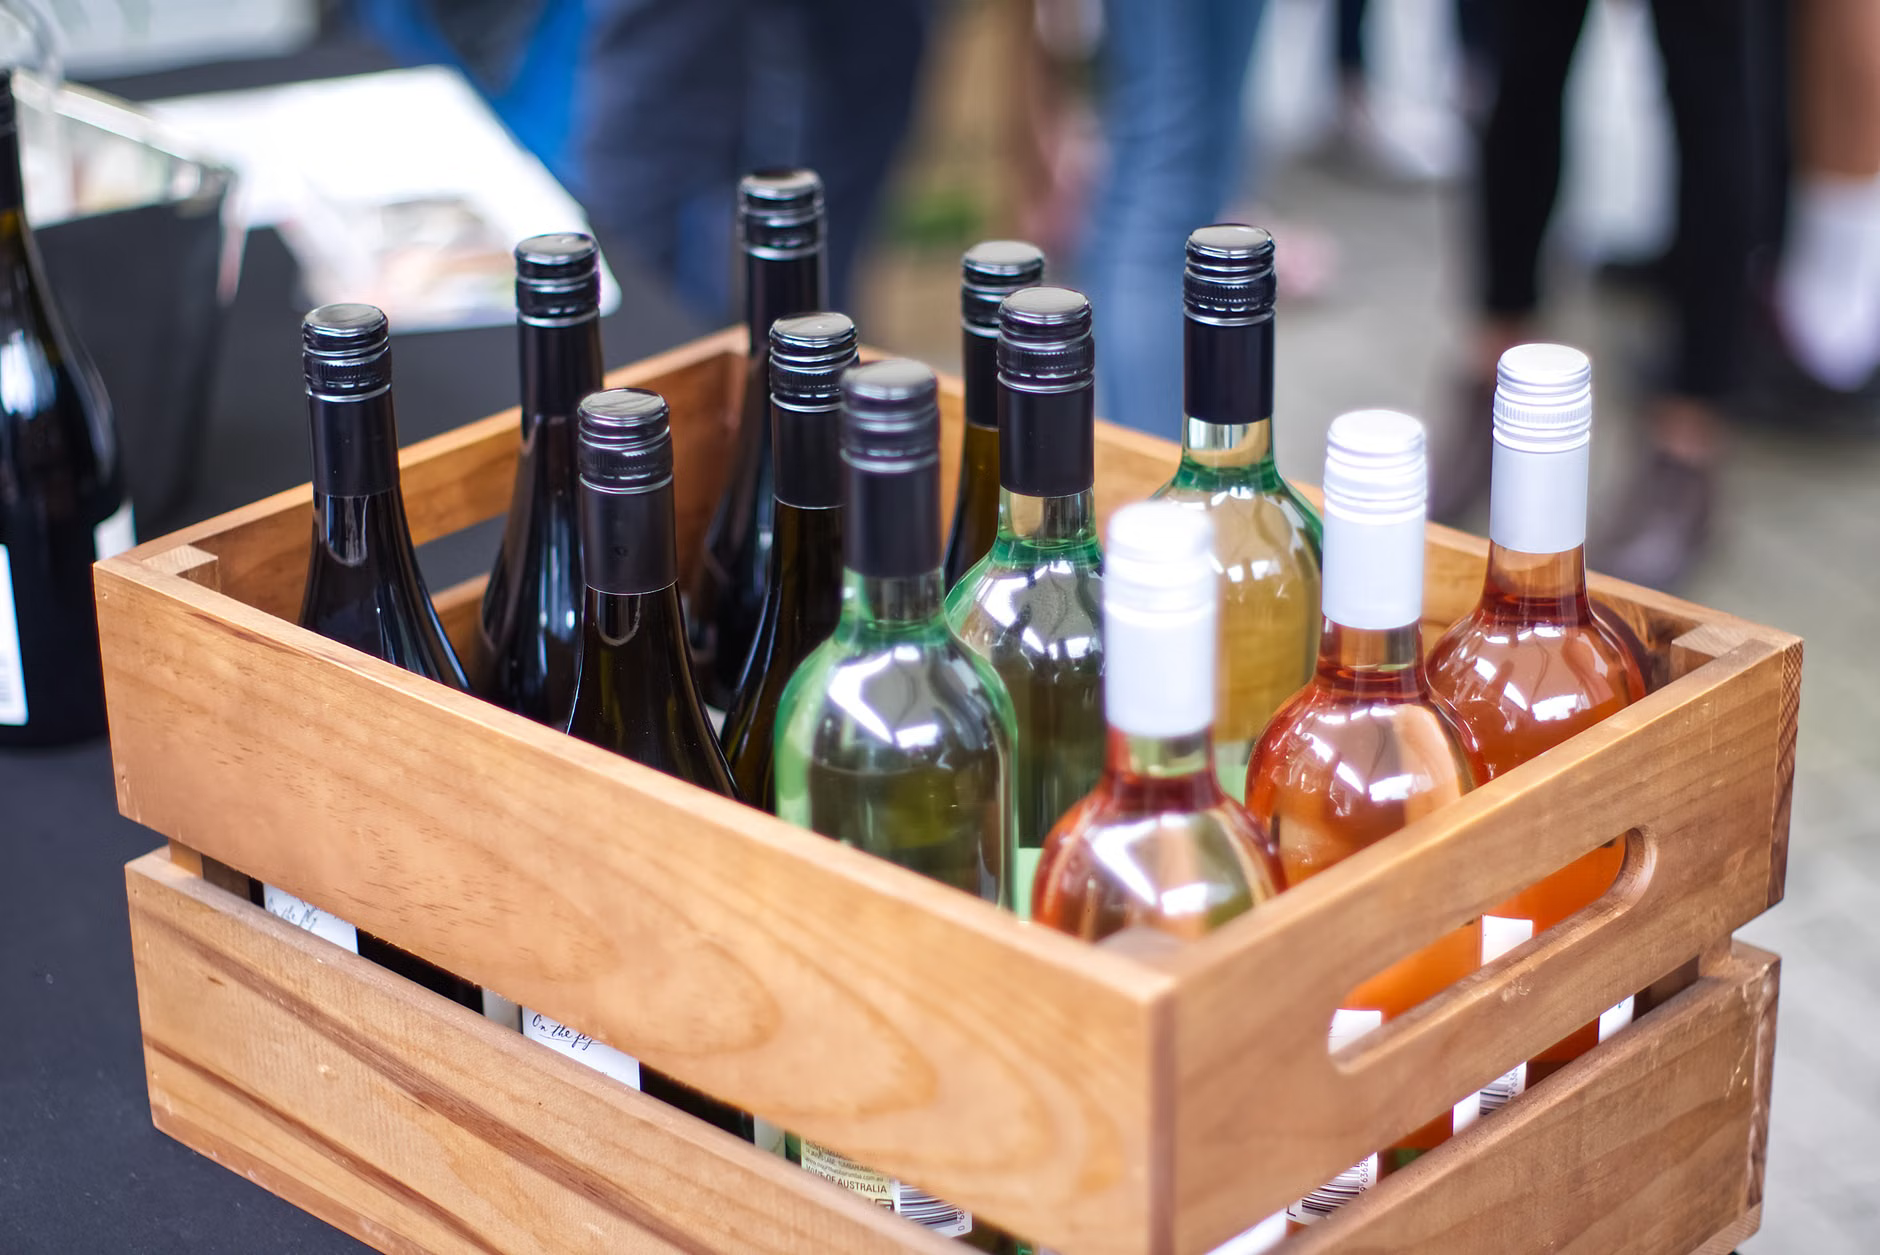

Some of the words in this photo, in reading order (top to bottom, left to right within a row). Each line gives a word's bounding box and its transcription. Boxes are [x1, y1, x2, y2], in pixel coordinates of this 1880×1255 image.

[532, 1013, 548, 1032] On
[550, 1024, 573, 1039] the
[837, 1178, 888, 1194] AUSTRALIA
